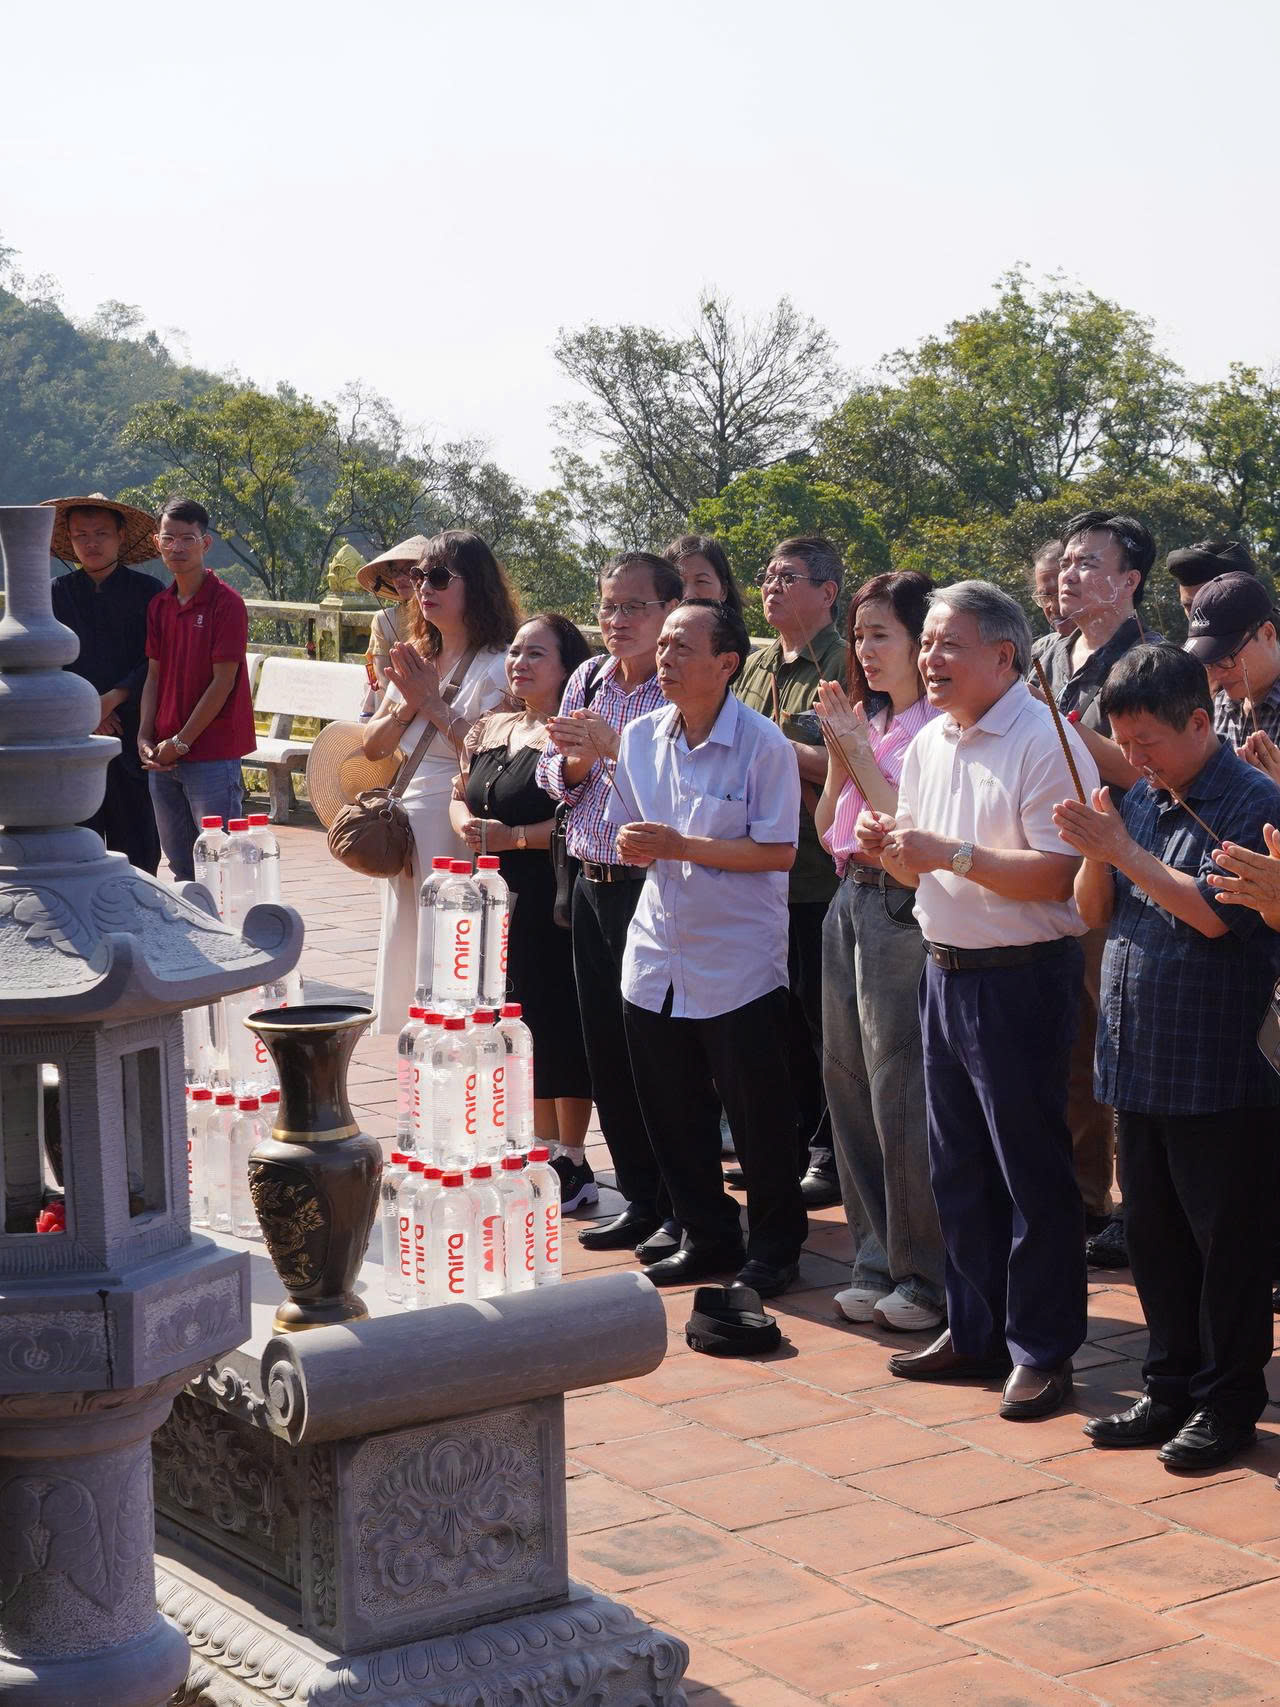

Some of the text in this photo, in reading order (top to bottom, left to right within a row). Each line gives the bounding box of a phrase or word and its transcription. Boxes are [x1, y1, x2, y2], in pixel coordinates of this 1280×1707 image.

[453, 919, 471, 980] mira
[465, 1074, 477, 1134] mira
[493, 1067, 504, 1127] mira
[400, 1216, 411, 1276] mira
[415, 1224, 425, 1284] mira
[448, 1233, 464, 1293] mira
[525, 1211, 535, 1271] mira
[546, 1204, 559, 1263] mira
